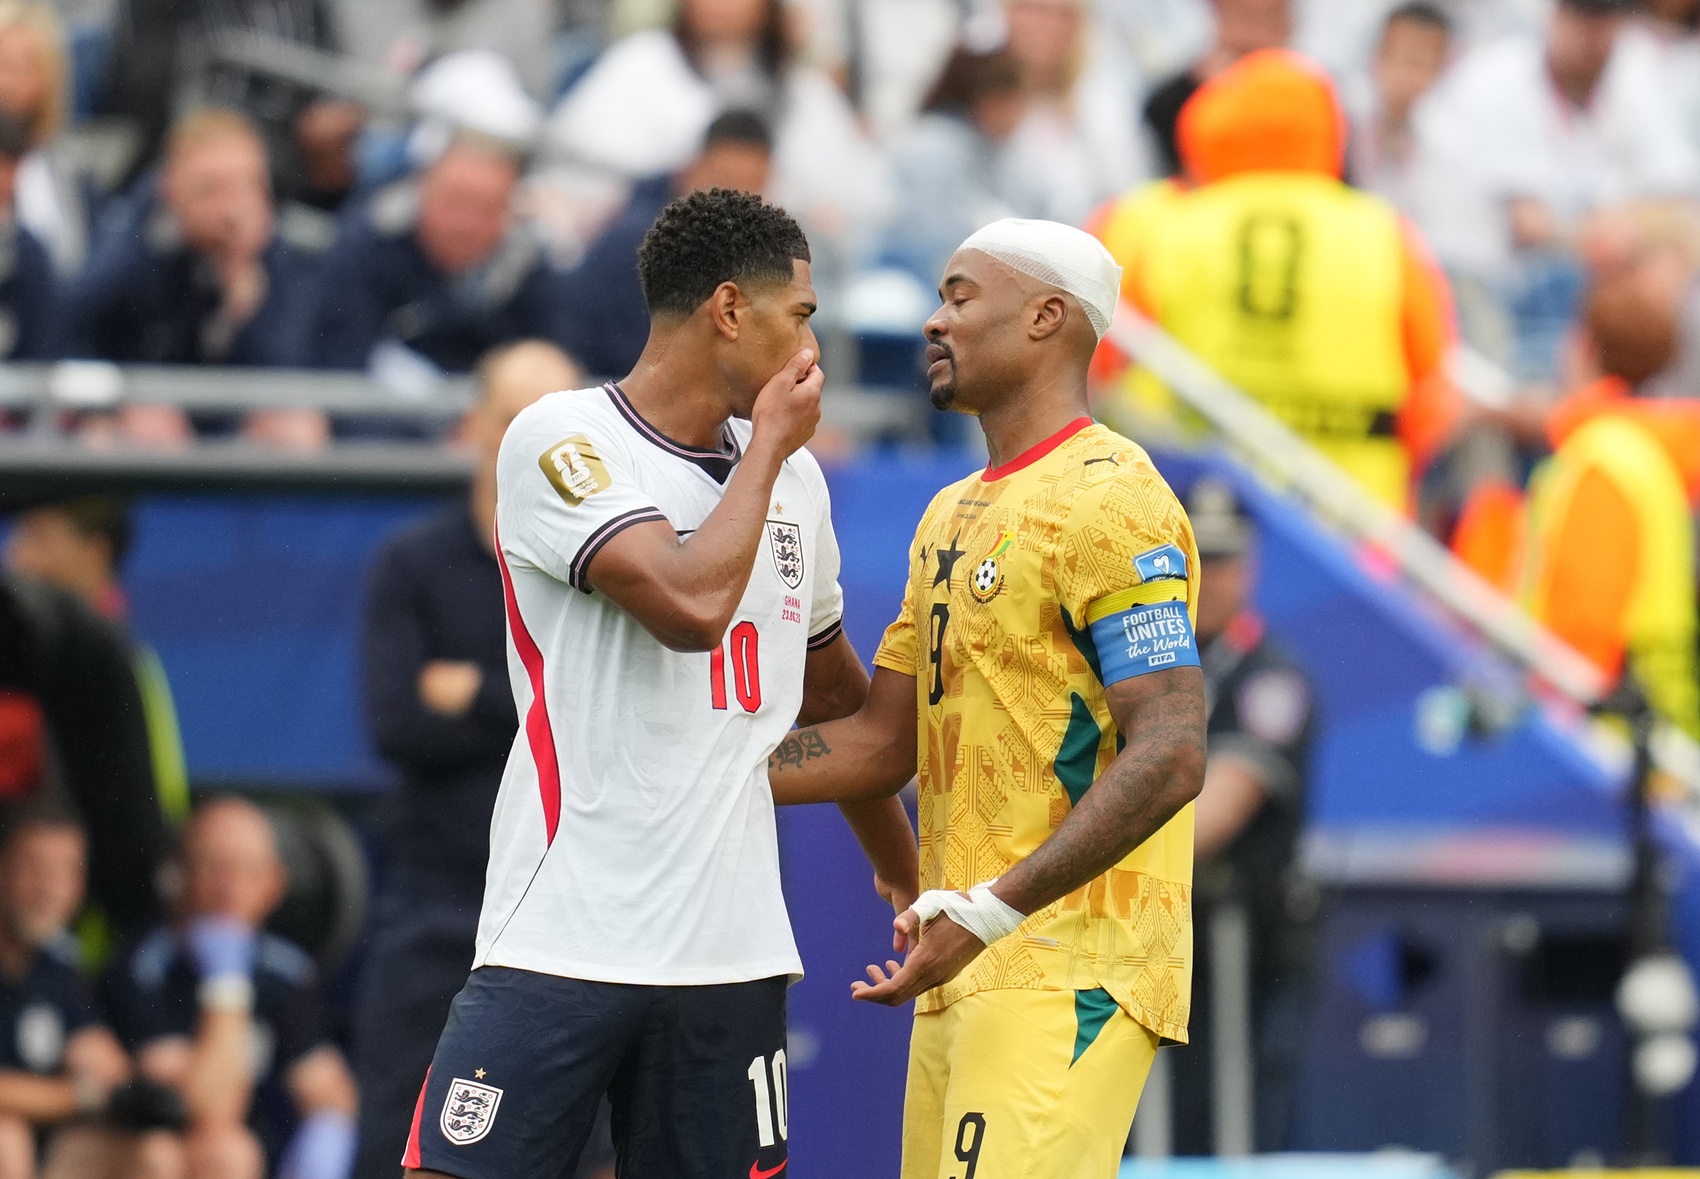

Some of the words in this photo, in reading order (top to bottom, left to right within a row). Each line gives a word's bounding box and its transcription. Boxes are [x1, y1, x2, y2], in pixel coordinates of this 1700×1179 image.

[784, 595, 801, 609] GHANA
[1122, 607, 1182, 628] FOOTBALL
[1124, 618, 1186, 643] UNITES
[929, 603, 950, 706] 9
[1125, 643, 1151, 659] the
[1153, 635, 1190, 653] World
[1151, 654, 1173, 664] FIFA
[710, 620, 762, 713] 10
[747, 1048, 788, 1148] 10
[949, 1111, 987, 1179] 9
